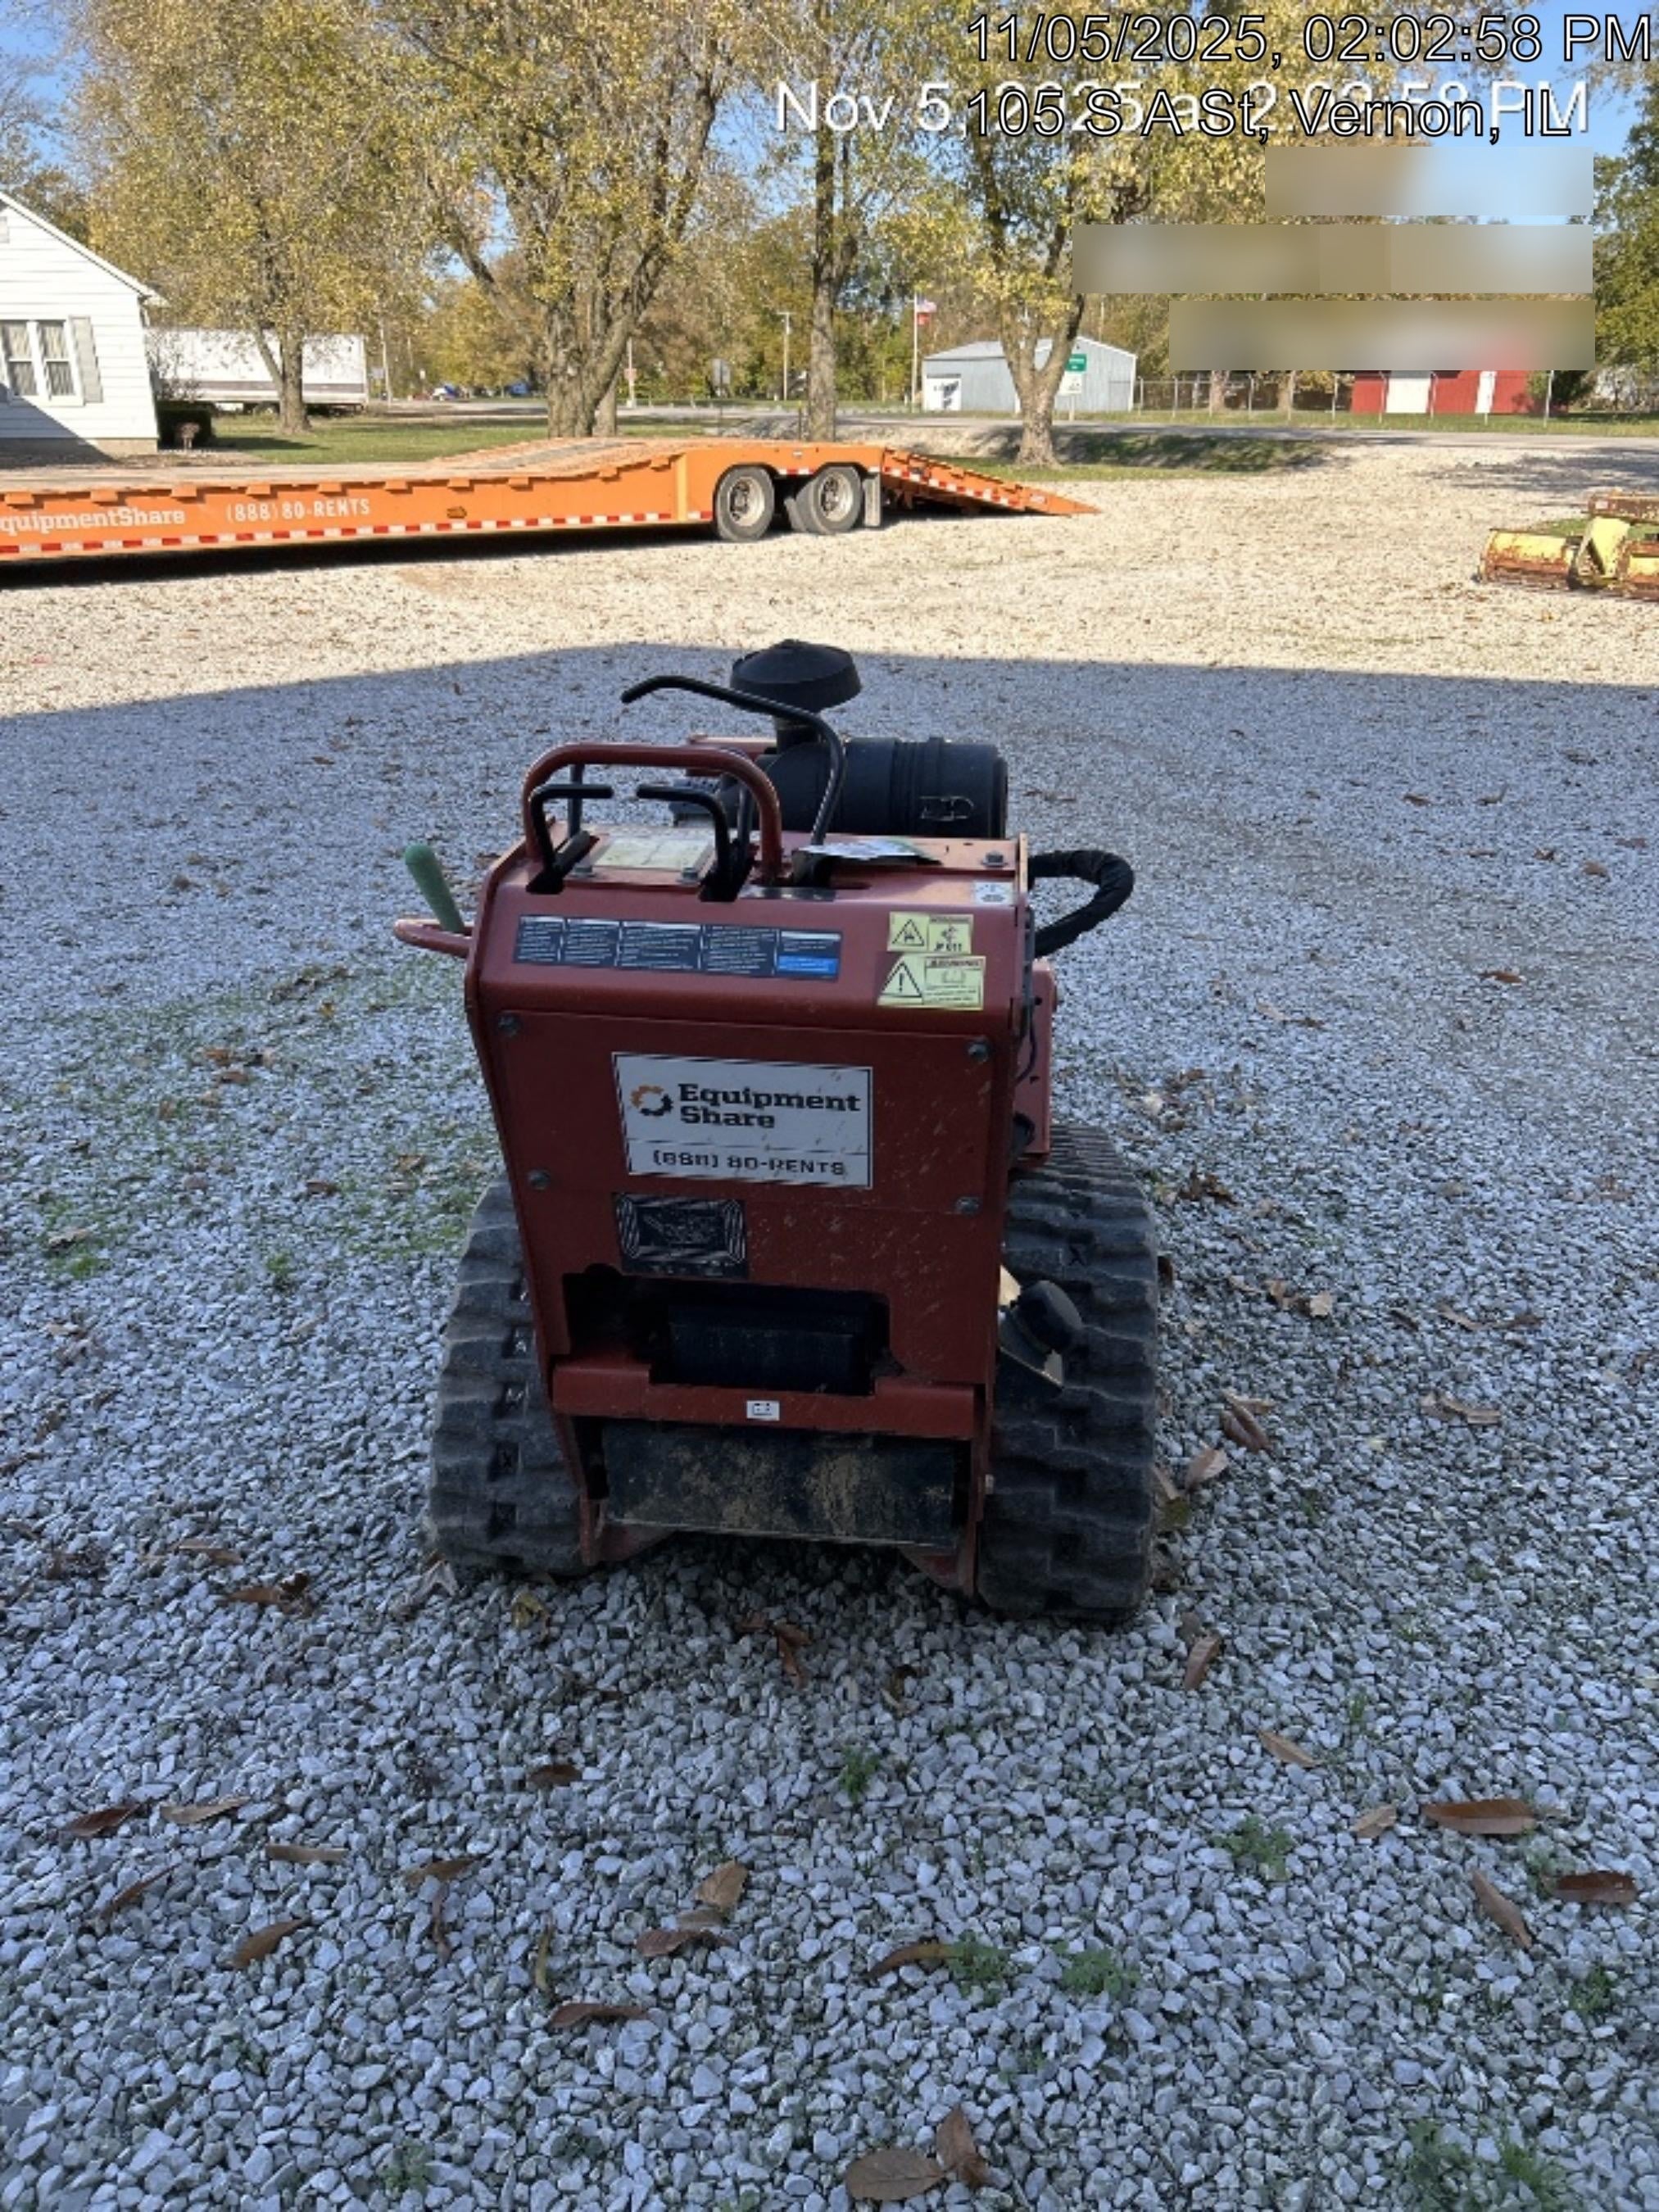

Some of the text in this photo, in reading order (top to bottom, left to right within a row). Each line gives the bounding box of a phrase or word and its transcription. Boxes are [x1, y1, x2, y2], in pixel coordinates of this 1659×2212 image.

[0, 507, 186, 537] quipmentShare
[225, 501, 279, 524] (888)
[678, 1082, 861, 1113] Equipment
[680, 1105, 775, 1129] Share
[727, 1154, 846, 1176] 80-RENTS
